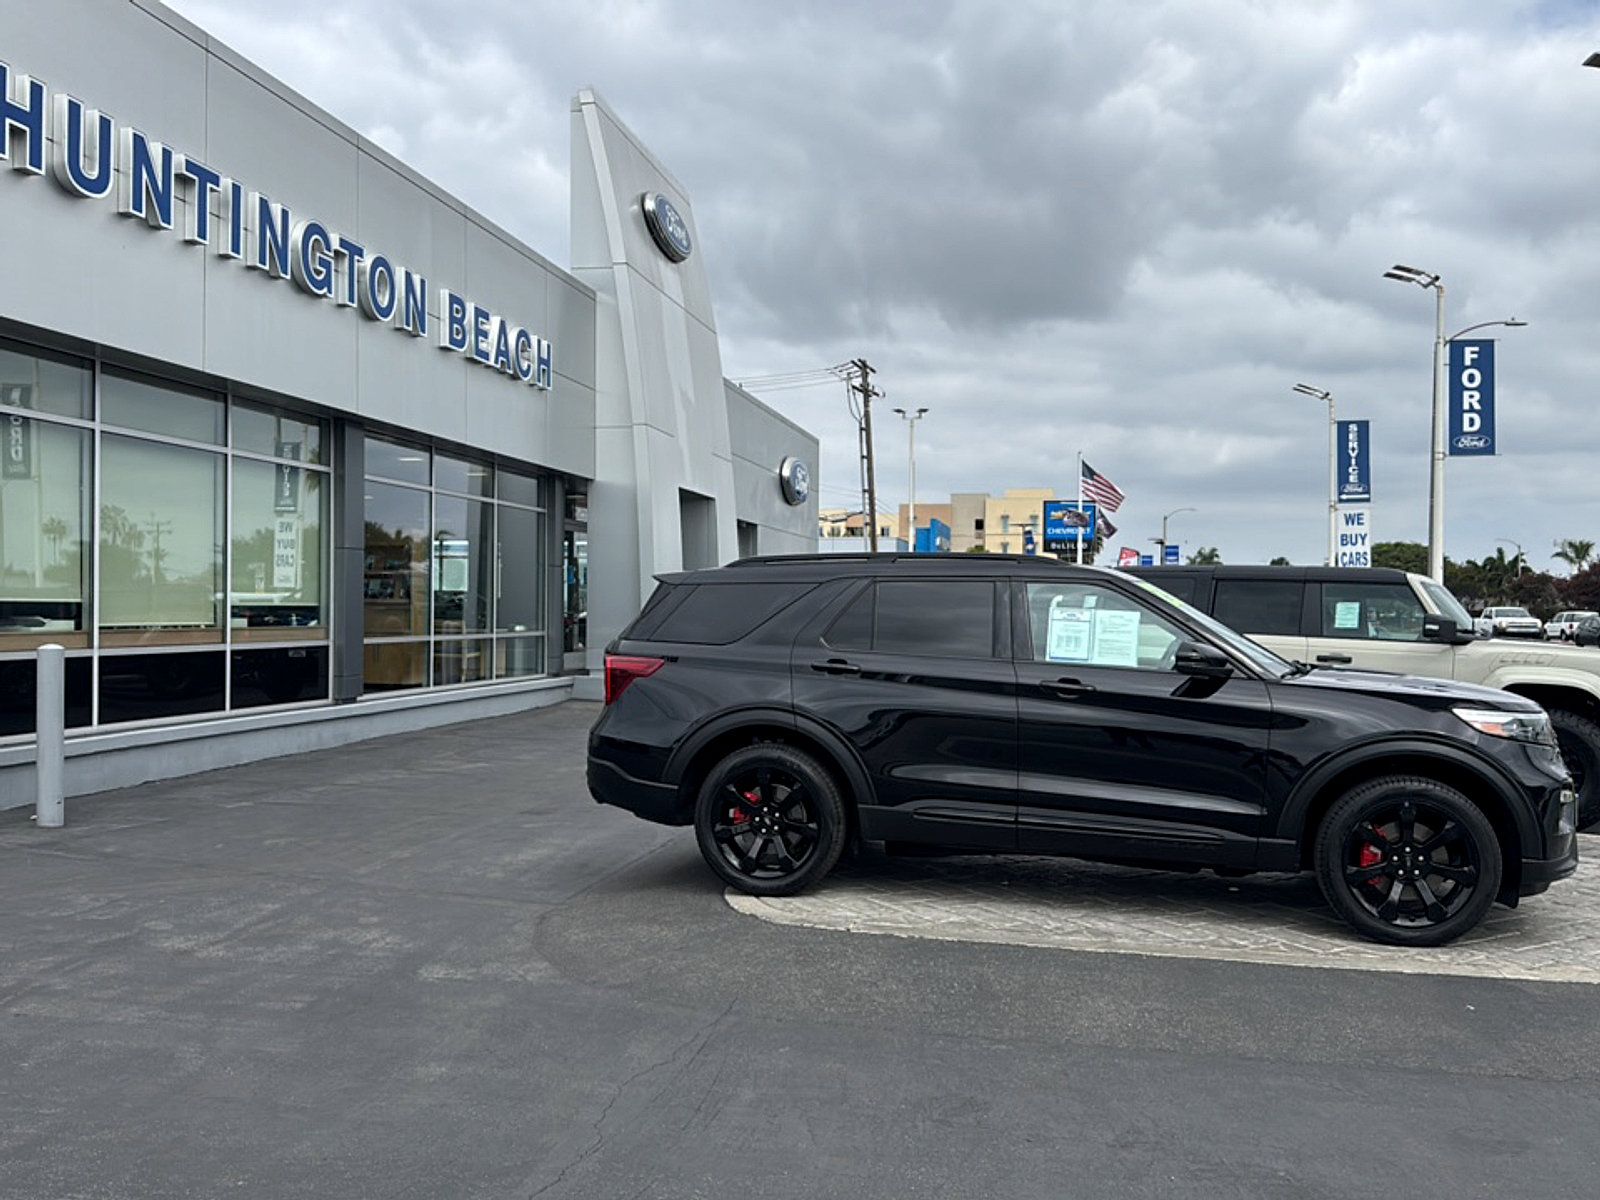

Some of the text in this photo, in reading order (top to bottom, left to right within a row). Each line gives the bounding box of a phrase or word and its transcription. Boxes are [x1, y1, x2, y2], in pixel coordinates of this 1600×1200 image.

[0, 61, 552, 390] HUNTINGTON BEACH
[1461, 346, 1482, 433] FORD
[1457, 435, 1487, 449] Ford
[1348, 423, 1359, 483] SERVICE
[1344, 513, 1365, 526] WE
[1340, 533, 1368, 546] BUY
[1340, 552, 1369, 567] CARS
